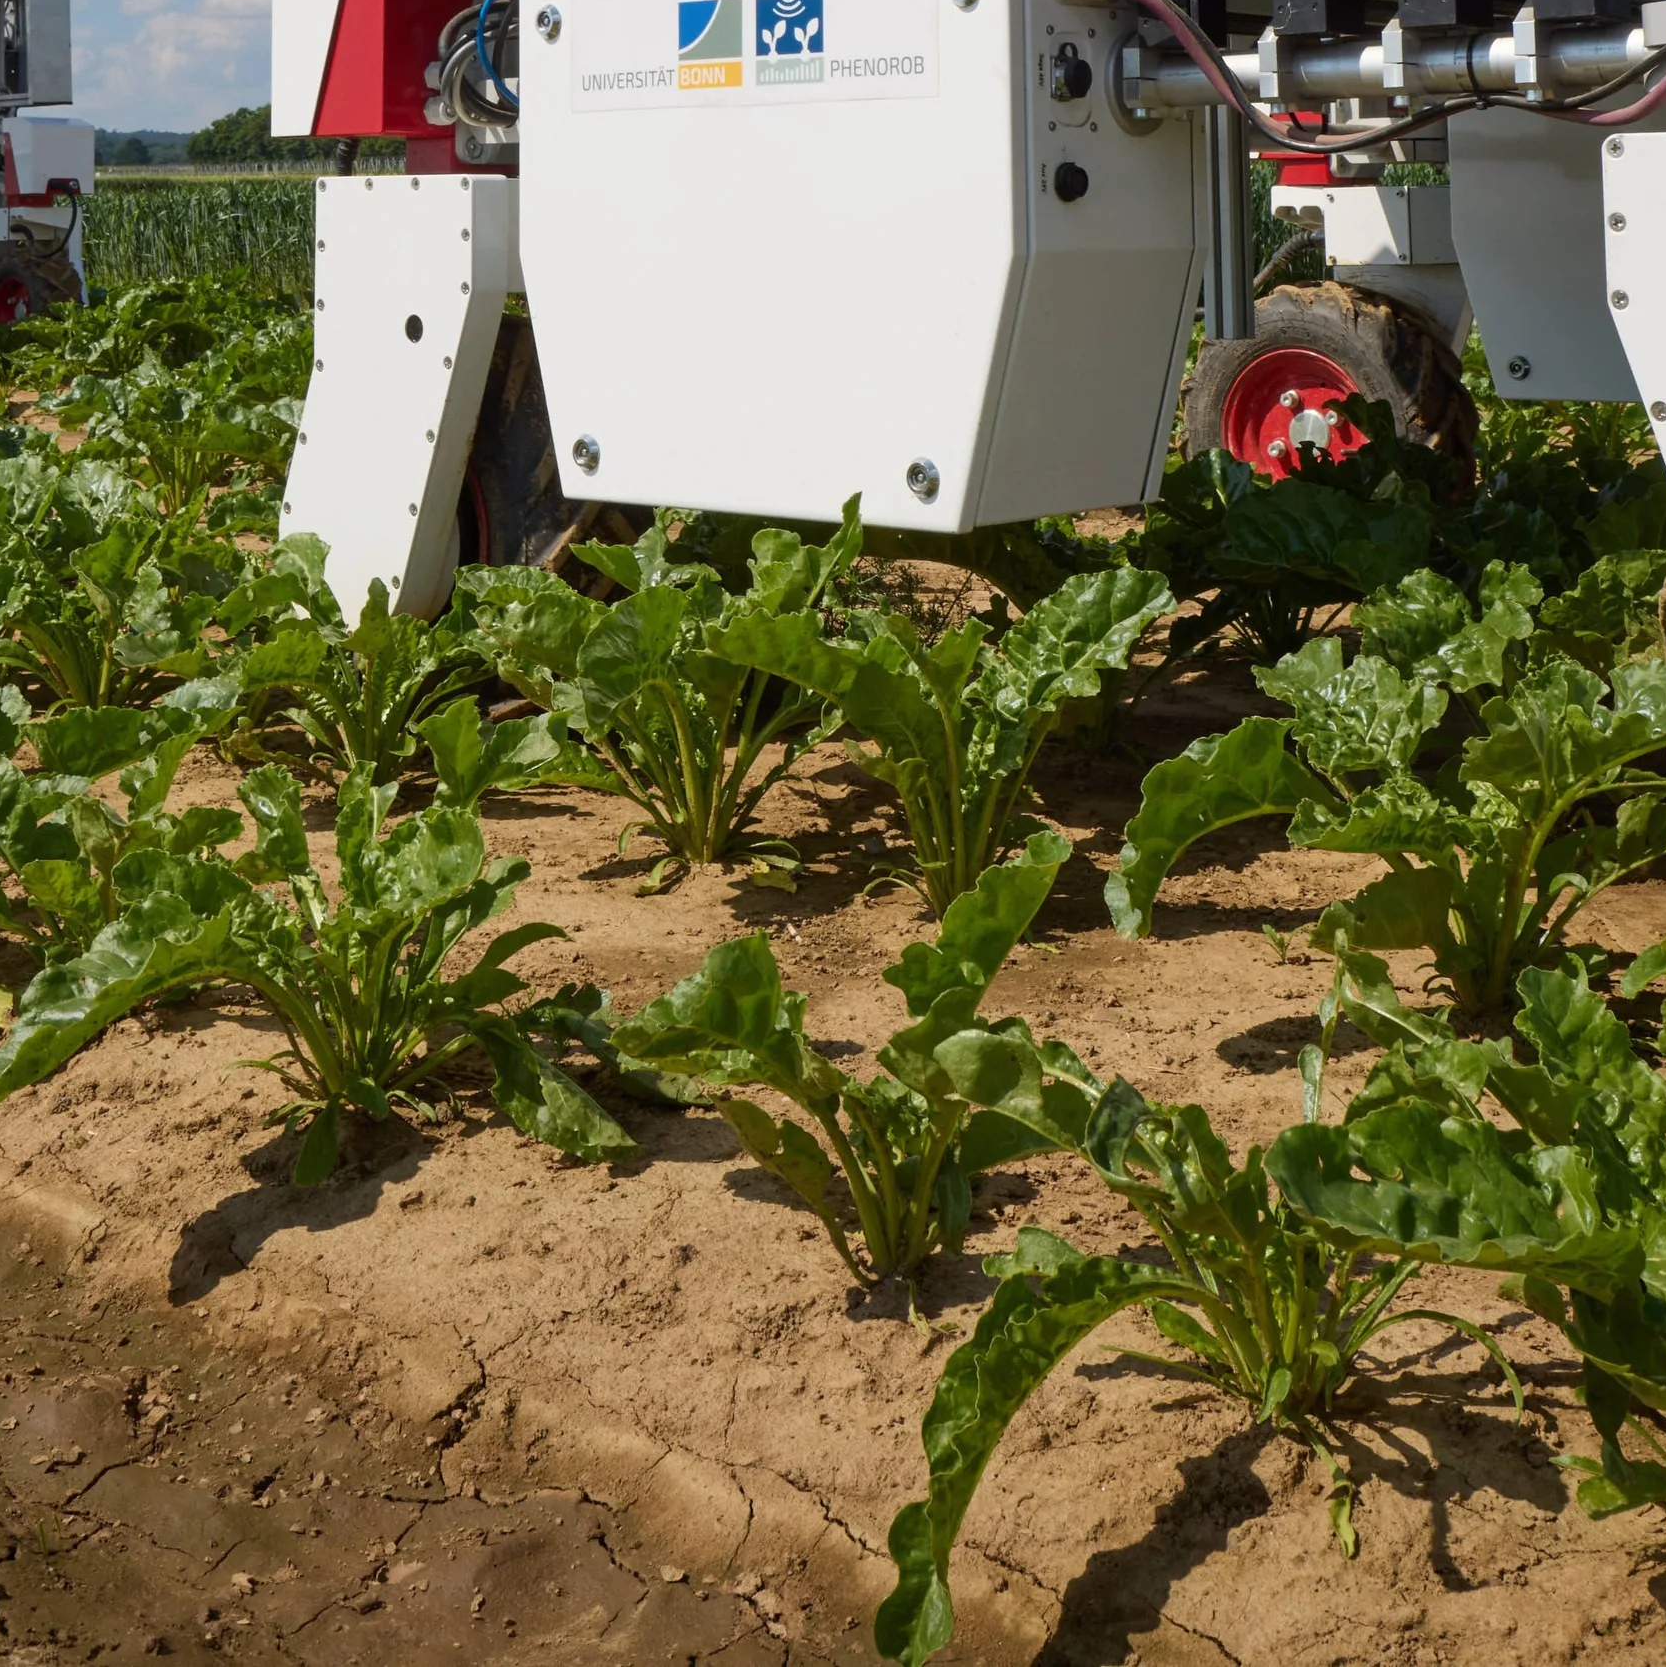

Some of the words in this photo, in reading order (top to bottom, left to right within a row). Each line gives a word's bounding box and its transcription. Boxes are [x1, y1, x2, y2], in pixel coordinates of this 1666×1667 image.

[581, 65, 676, 92] UNIVERSITÄT
[681, 66, 726, 86] BONN
[830, 55, 925, 78] PHENOROB
